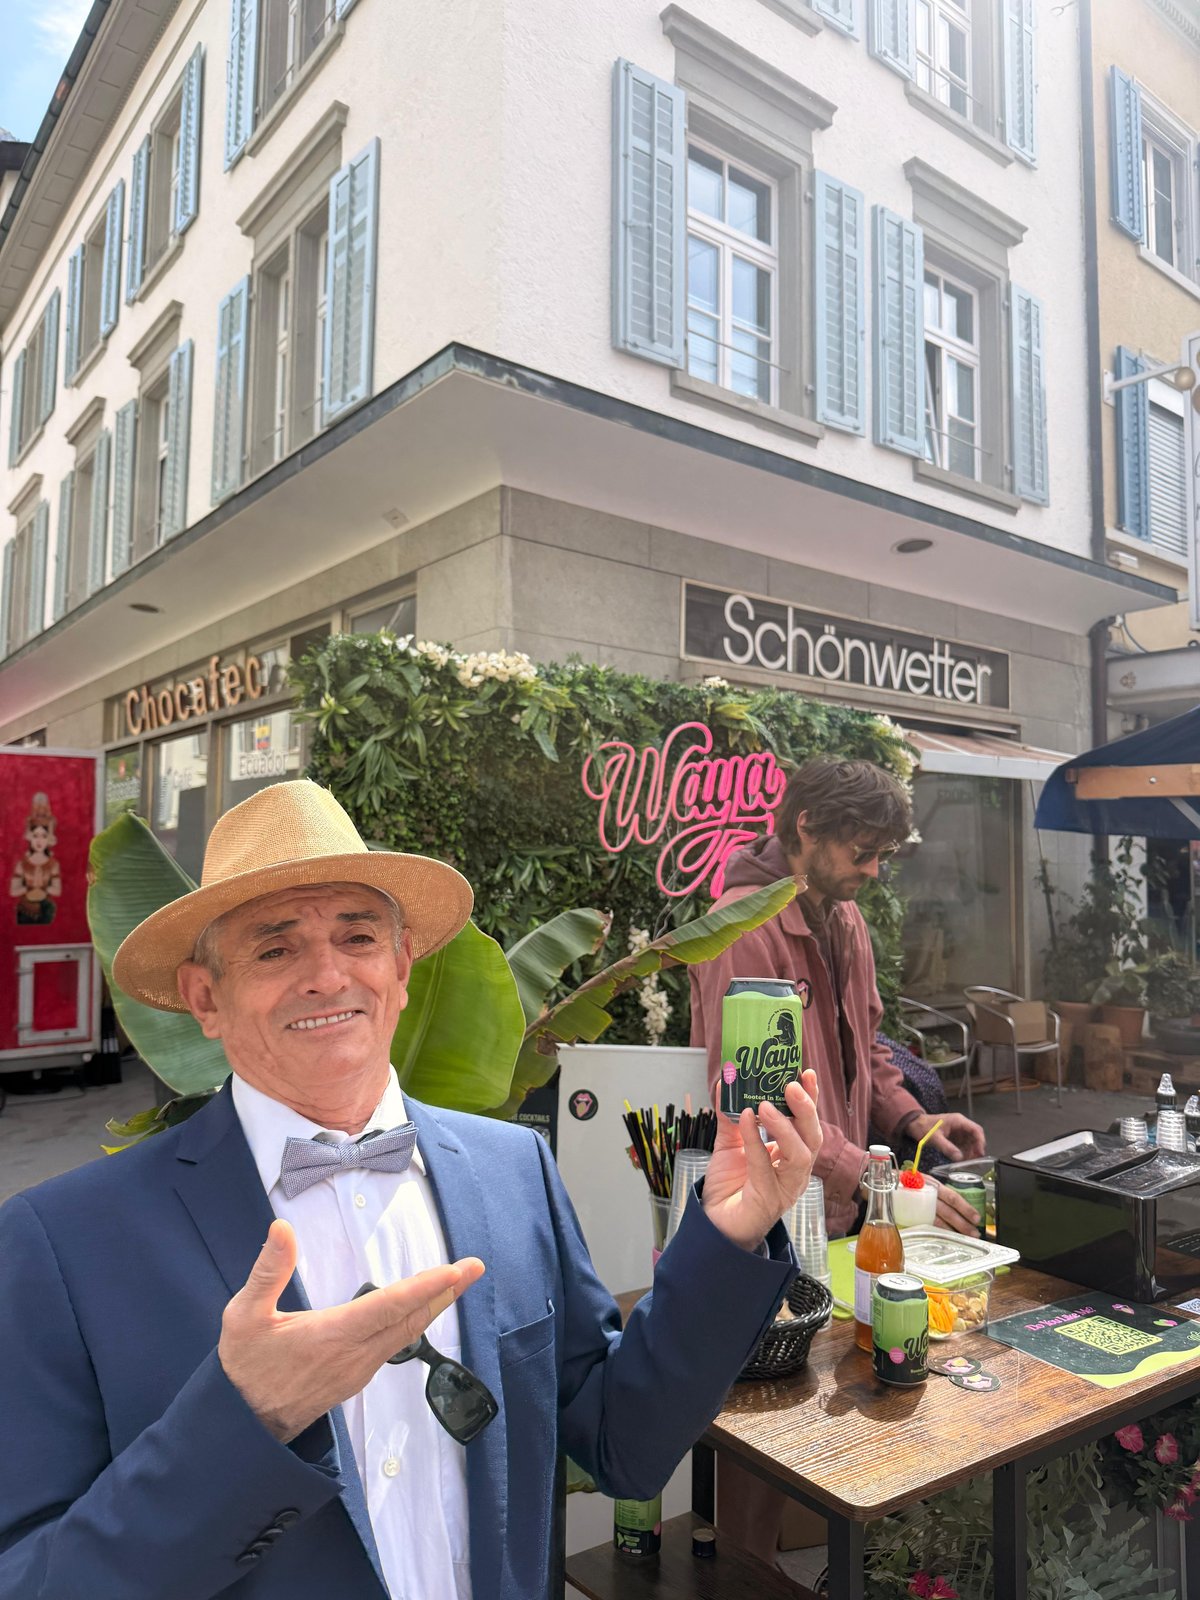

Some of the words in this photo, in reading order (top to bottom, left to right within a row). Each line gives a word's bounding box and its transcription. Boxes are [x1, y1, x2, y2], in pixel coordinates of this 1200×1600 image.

[723, 595, 992, 704] Schönwetter
[126, 655, 263, 735] Chocafec
[239, 752, 288, 776] Ecuador
[519, 1113, 551, 1123] COCKTAILS
